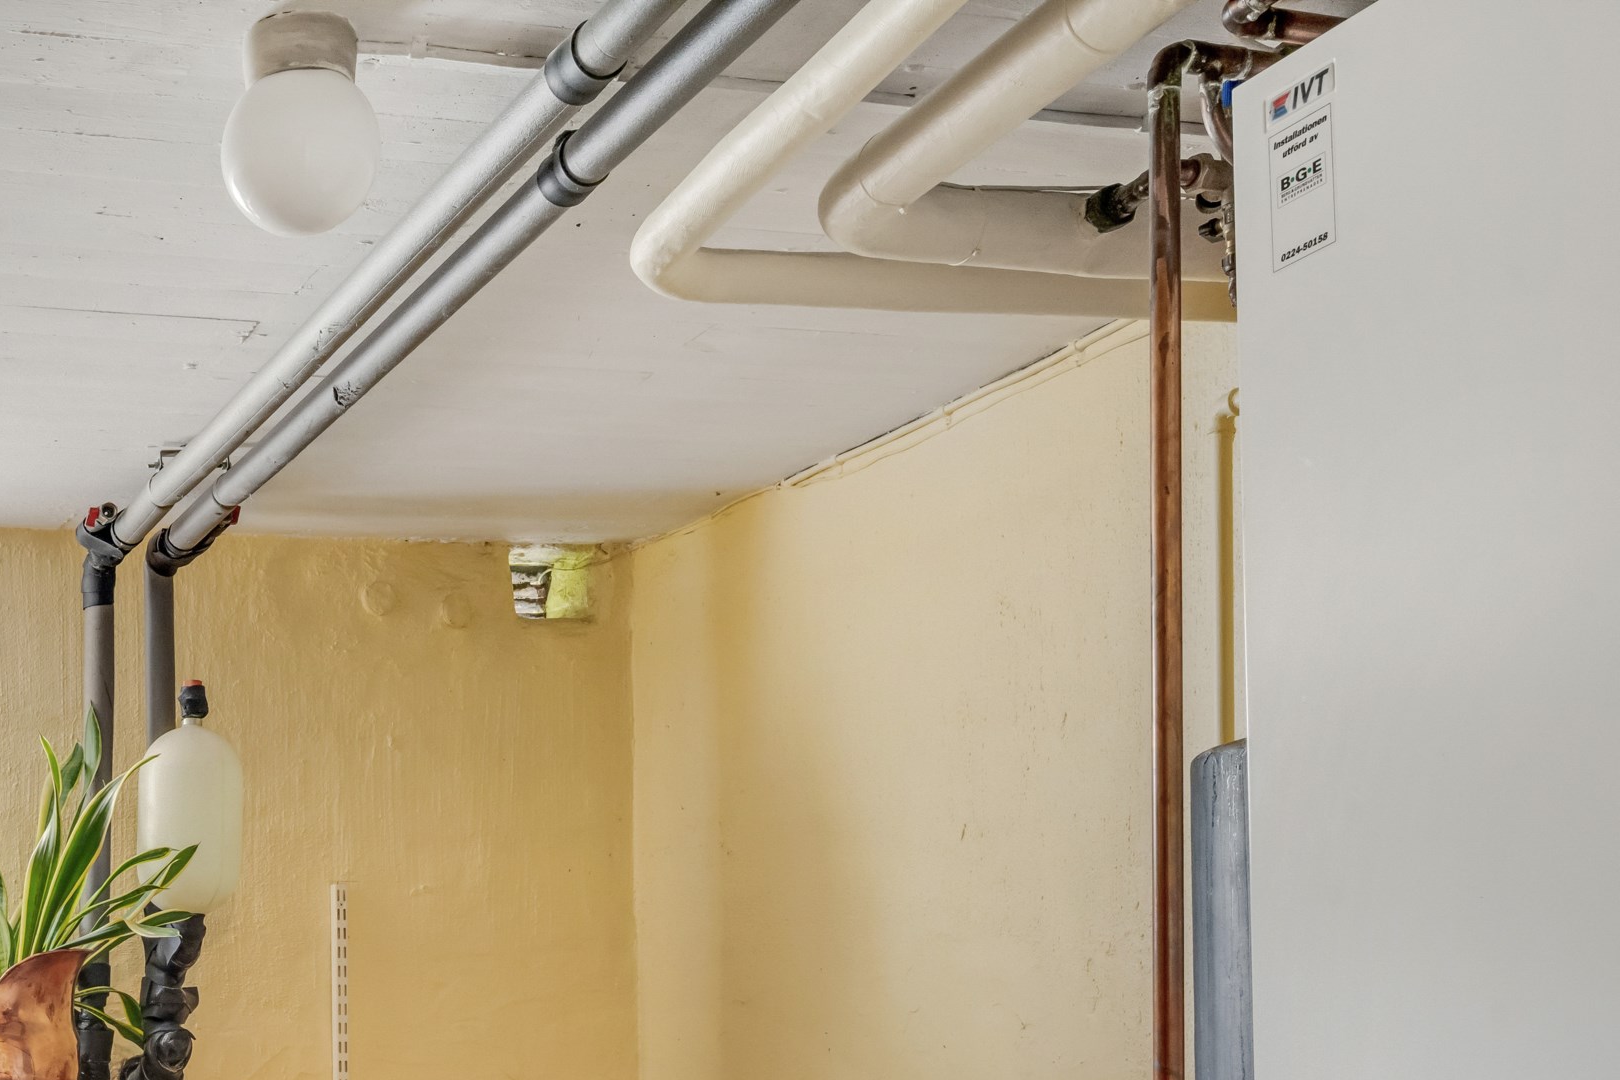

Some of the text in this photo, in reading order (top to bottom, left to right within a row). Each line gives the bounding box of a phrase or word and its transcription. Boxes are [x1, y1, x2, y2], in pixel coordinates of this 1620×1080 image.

[1292, 68, 1329, 110] IVT
[1273, 115, 1327, 150] Installationen
[1309, 132, 1319, 143] av
[1281, 231, 1328, 262] 0224-50158
